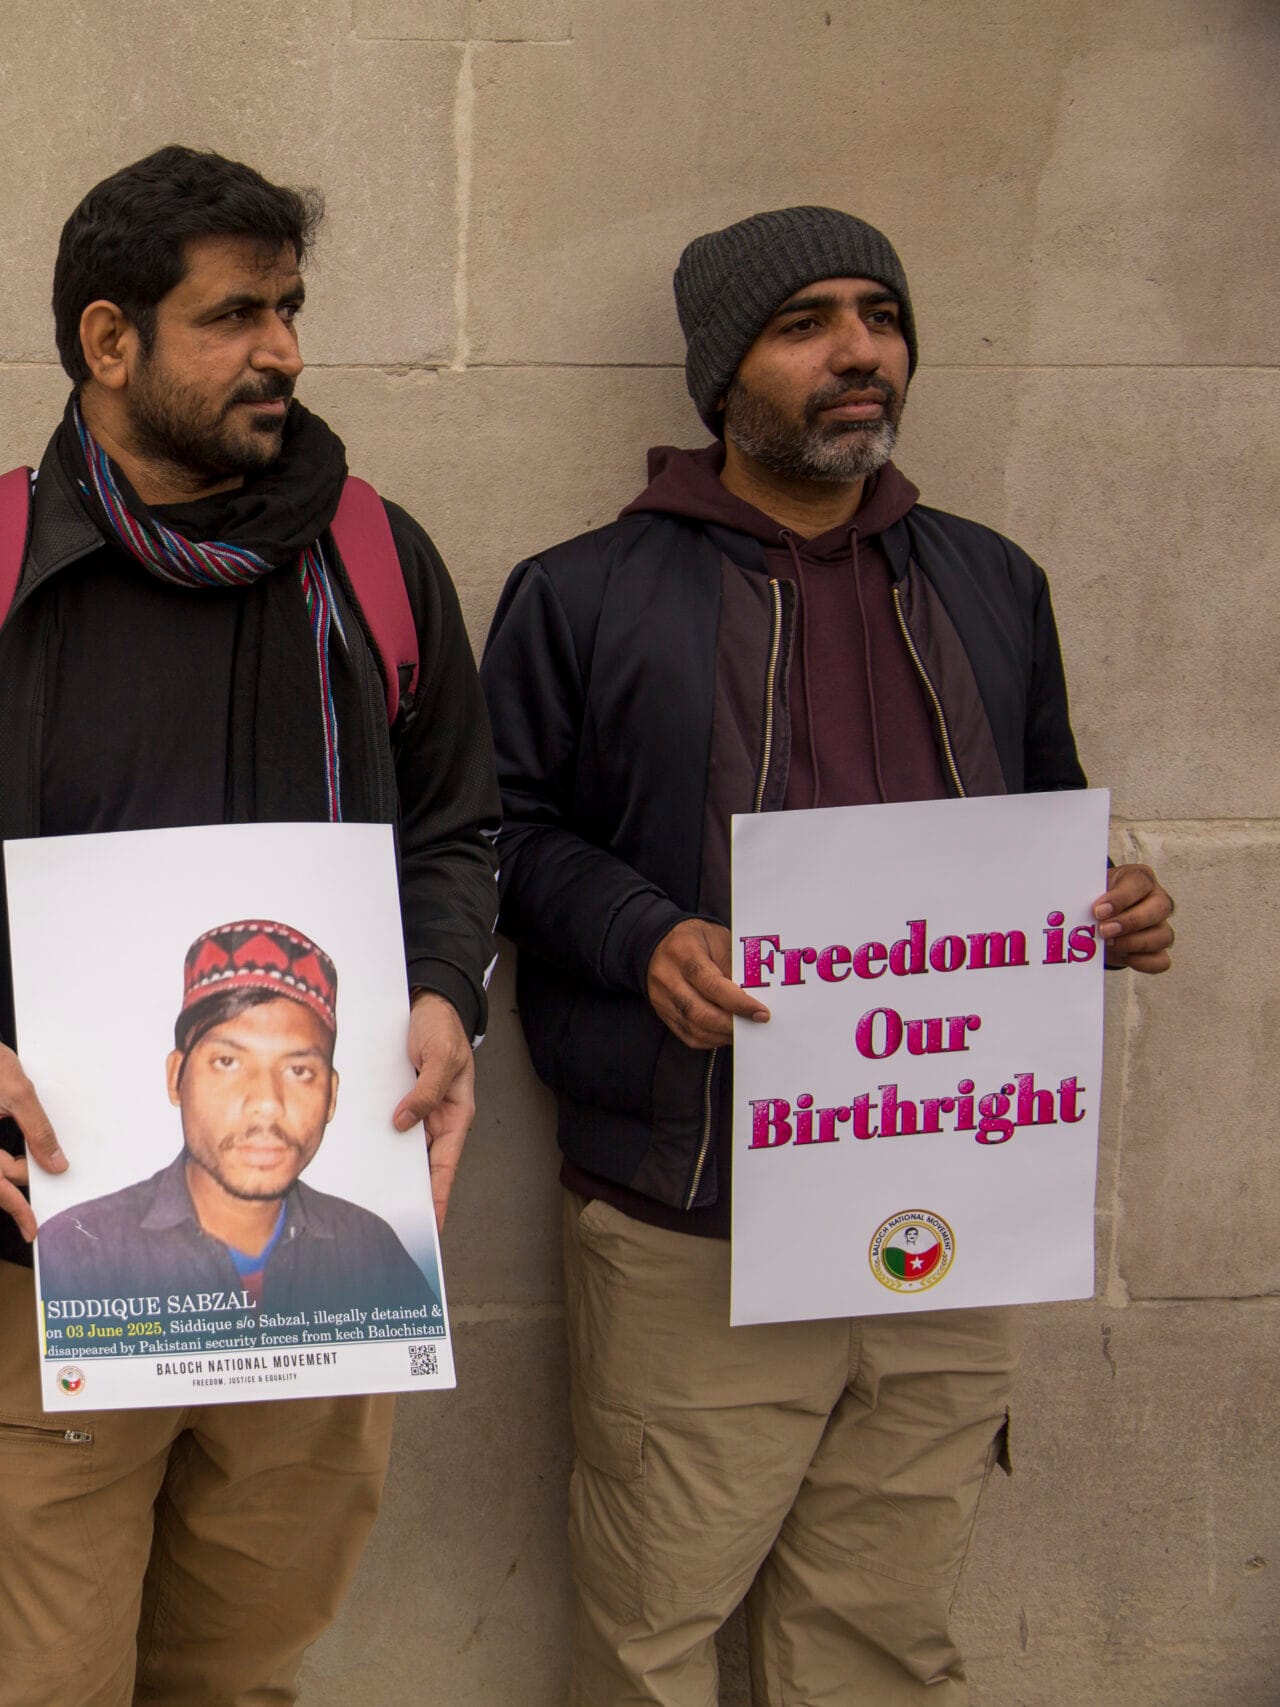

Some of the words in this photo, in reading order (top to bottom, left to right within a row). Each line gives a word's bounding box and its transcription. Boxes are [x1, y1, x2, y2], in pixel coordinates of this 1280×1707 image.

[739, 919, 1030, 989] Freedom
[1042, 911, 1098, 965] is
[854, 1006, 982, 1060] Our
[747, 1072, 1086, 1150] Birthright
[872, 1226, 890, 1257] BALOCH
[888, 1213, 925, 1228] NATIONAL
[926, 1215, 952, 1251] MOVEMENT
[46, 1328, 62, 1339] on
[66, 1325, 84, 1338] 03
[87, 1323, 123, 1338] June
[127, 1321, 166, 1337] 2025,
[170, 1318, 232, 1335] Siddique
[236, 1315, 255, 1329] s/o
[259, 1311, 310, 1328] Sabzal,
[314, 1308, 367, 1325] illegally
[371, 1305, 428, 1321] detained
[431, 1303, 443, 1317] &
[47, 1296, 161, 1320] SIDDIQUE
[167, 1290, 257, 1314] SABZAL
[48, 1343, 117, 1358] disappeared
[120, 1343, 135, 1356] by
[139, 1337, 201, 1353] Pakistani
[205, 1333, 256, 1349] security
[261, 1332, 299, 1346] forces
[302, 1330, 332, 1342] from
[335, 1327, 364, 1340] kech
[368, 1323, 444, 1339] Balochistan
[156, 1361, 202, 1376] BALOCH
[208, 1356, 268, 1373] NATIONAL
[273, 1352, 338, 1368] MOVEMENT
[229, 1375, 255, 1384] JUSTICE
[265, 1373, 297, 1382] EQUALITY
